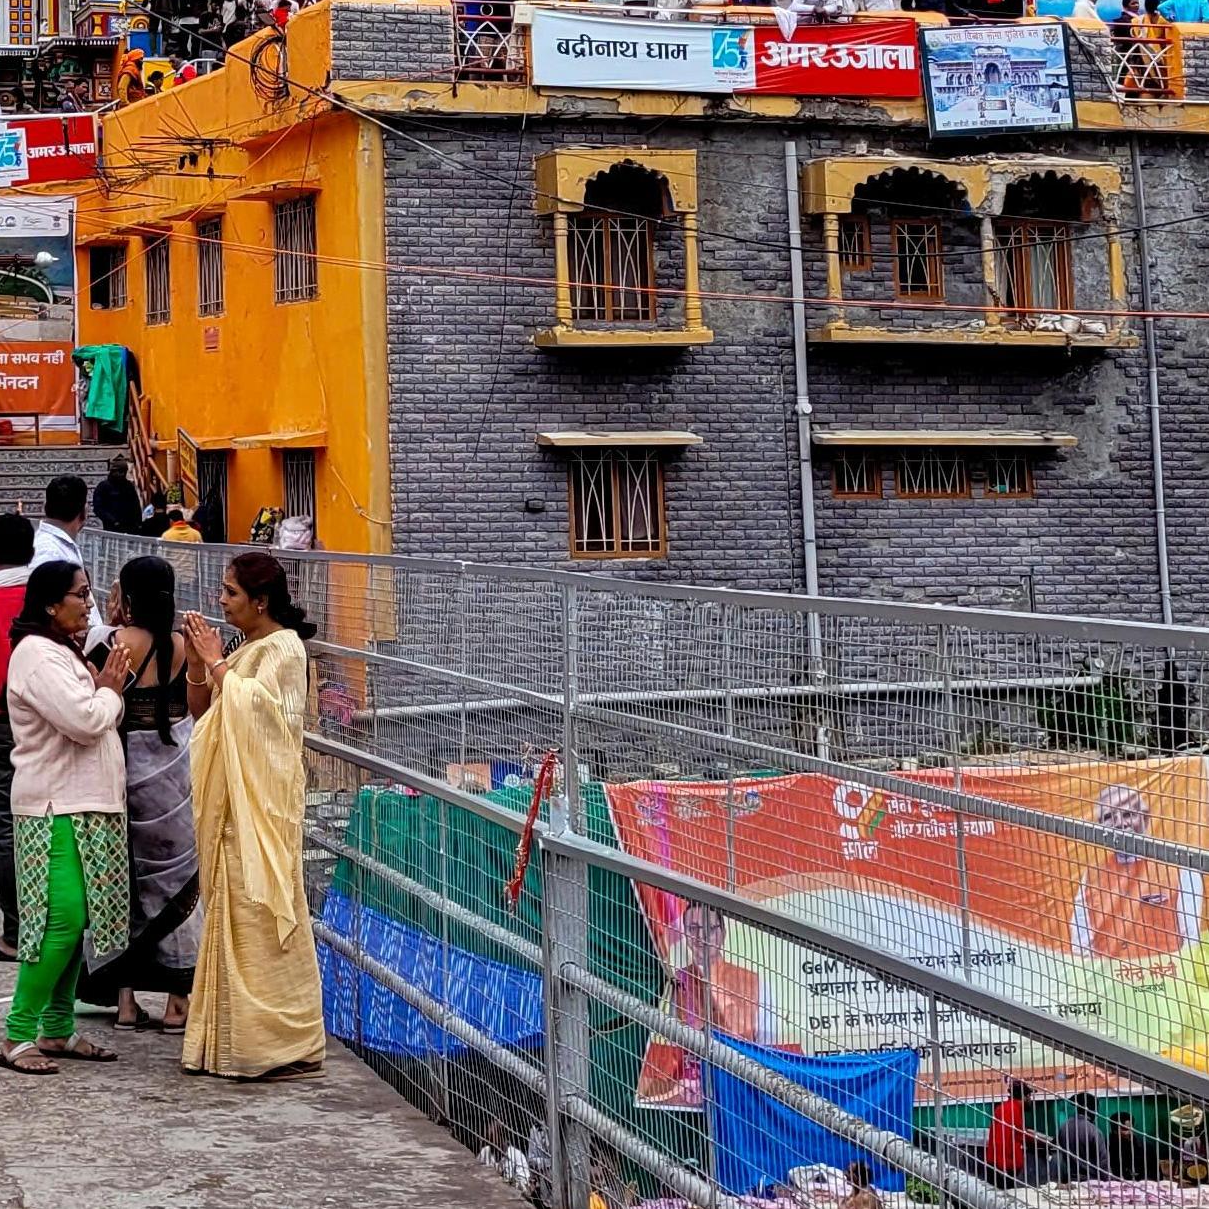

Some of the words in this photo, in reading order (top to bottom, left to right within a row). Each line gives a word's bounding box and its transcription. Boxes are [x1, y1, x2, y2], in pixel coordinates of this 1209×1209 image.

[556, 34, 638, 59] बद्रीनाथ
[802, 961, 838, 975] GeM
[809, 1014, 840, 1030] DBT
